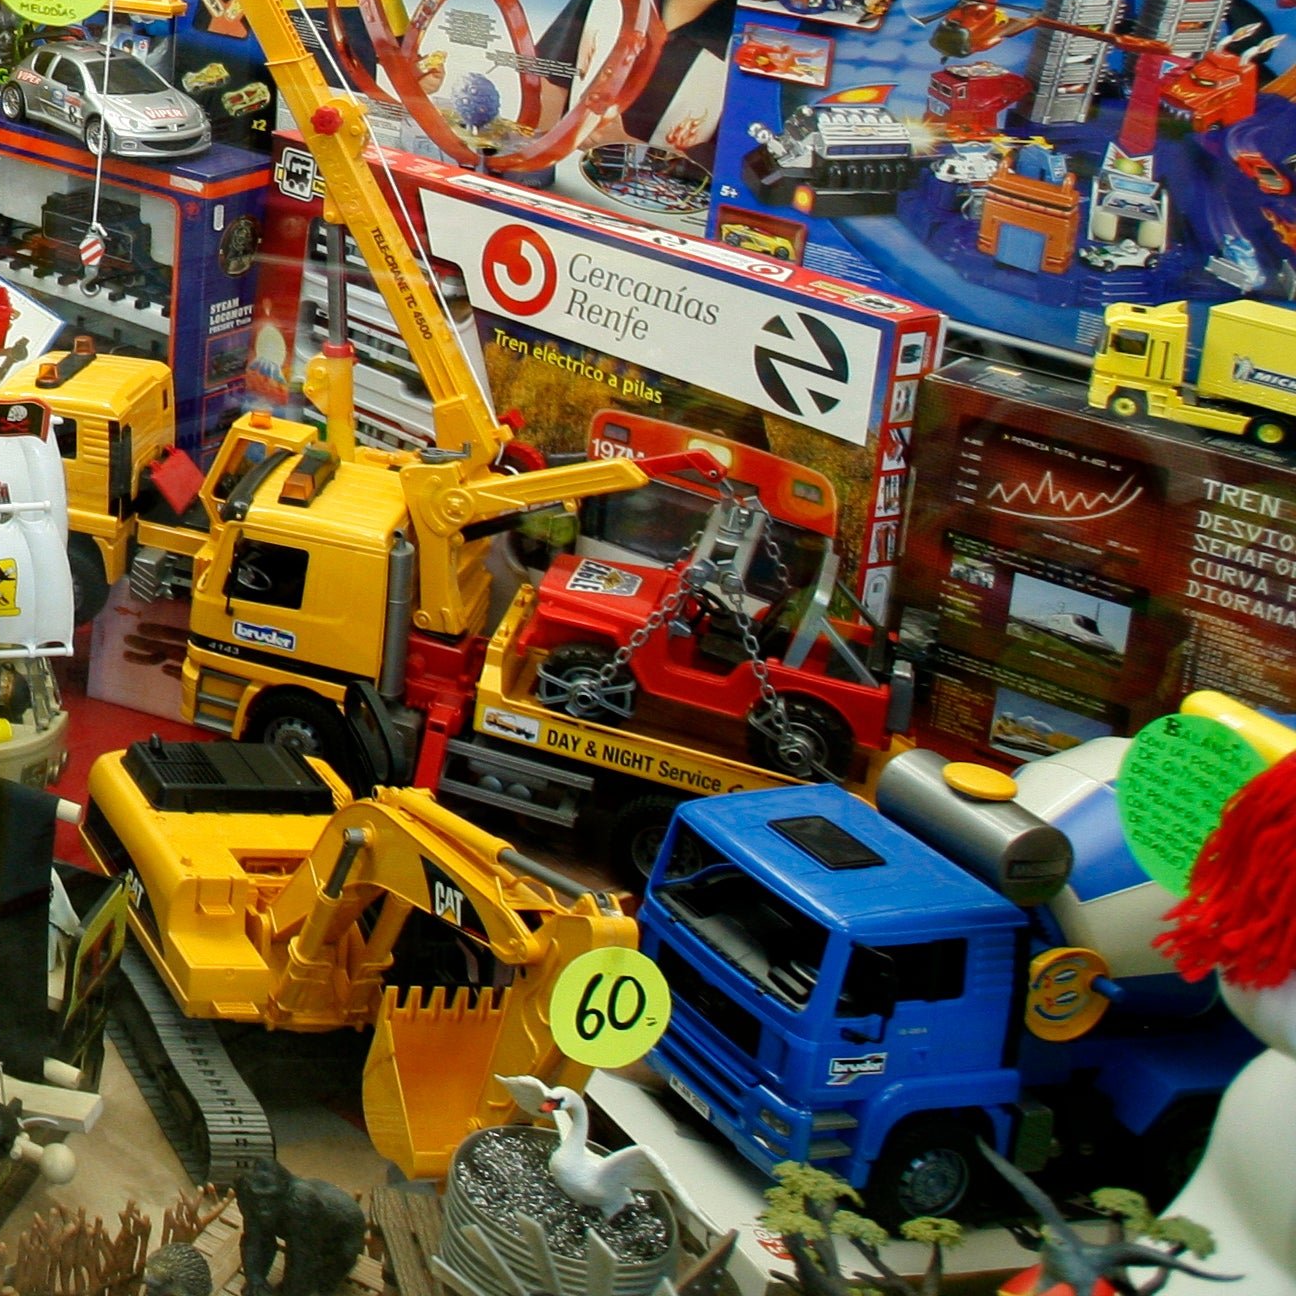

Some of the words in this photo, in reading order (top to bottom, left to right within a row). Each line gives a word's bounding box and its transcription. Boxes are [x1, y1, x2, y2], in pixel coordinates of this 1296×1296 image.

[16, 70, 42, 86] VIPER
[144, 107, 185, 120] VIPER
[251, 119, 267, 132] x2
[719, 186, 739, 200] 5+
[370, 226, 409, 299] TELE-CRANE
[411, 307, 434, 340] 4500
[567, 253, 721, 325] Cercanías
[565, 290, 650, 341] Renfe
[494, 328, 530, 357] Tren
[533, 340, 604, 384] eléctrico
[607, 372, 618, 387] a
[622, 373, 664, 405] pilas
[1201, 477, 1281, 519] TREN
[1189, 557, 1270, 596] CURVA
[235, 621, 295, 649] bruder
[546, 727, 581, 754] DAY
[584, 740, 598, 757] &
[601, 745, 655, 774] NIGHT
[658, 759, 722, 793] Service
[434, 880, 464, 925] CAT
[832, 1057, 886, 1075] bruder
